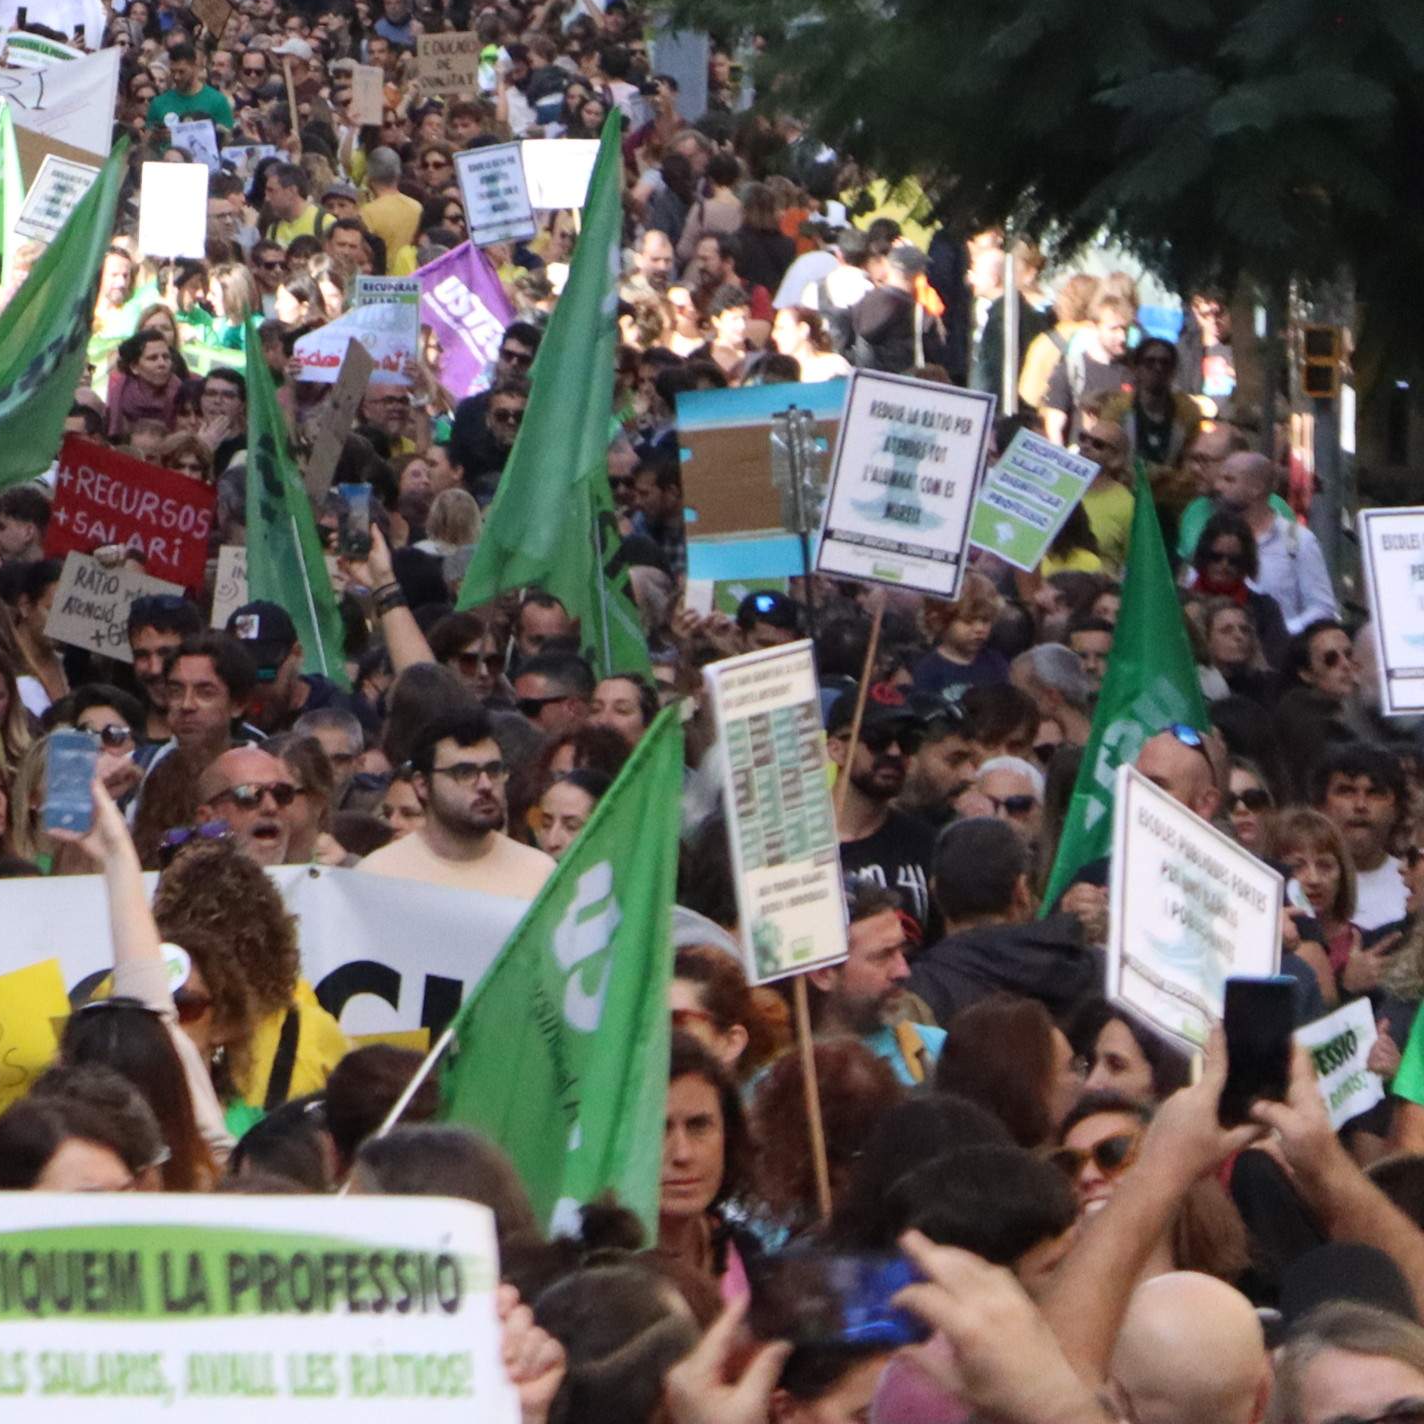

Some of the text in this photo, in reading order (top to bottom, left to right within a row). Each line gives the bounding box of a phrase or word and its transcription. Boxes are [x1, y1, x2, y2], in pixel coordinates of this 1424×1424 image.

[160, 1249, 207, 1315] LA
[224, 1233, 466, 1316] PROFESSIÓ
[185, 1349, 275, 1398] AVALL
[289, 1349, 339, 1398] LES
